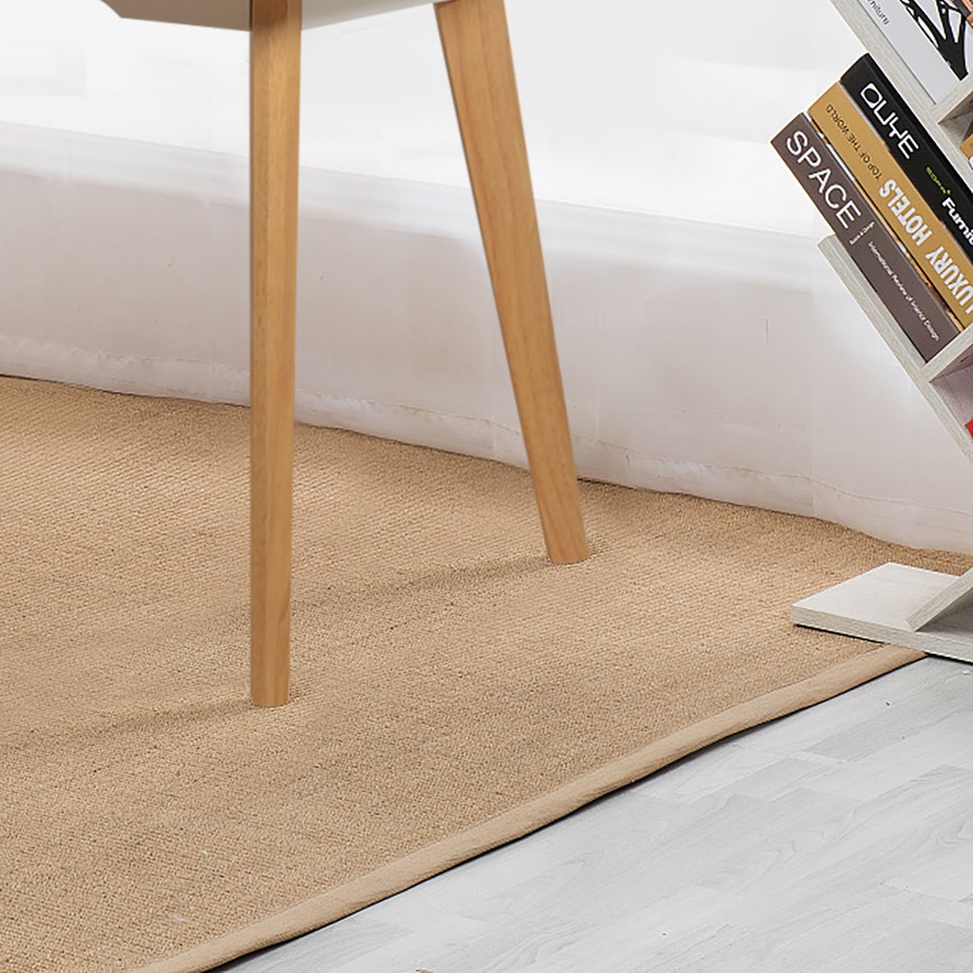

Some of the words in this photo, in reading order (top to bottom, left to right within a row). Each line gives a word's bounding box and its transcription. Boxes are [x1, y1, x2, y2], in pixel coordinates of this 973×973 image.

[825, 103, 851, 136] WORLD
[846, 133, 863, 153] THE
[858, 149, 872, 165] OF
[866, 160, 884, 181] TOP
[783, 128, 862, 230] SPACE
[877, 177, 933, 246] HOTELS
